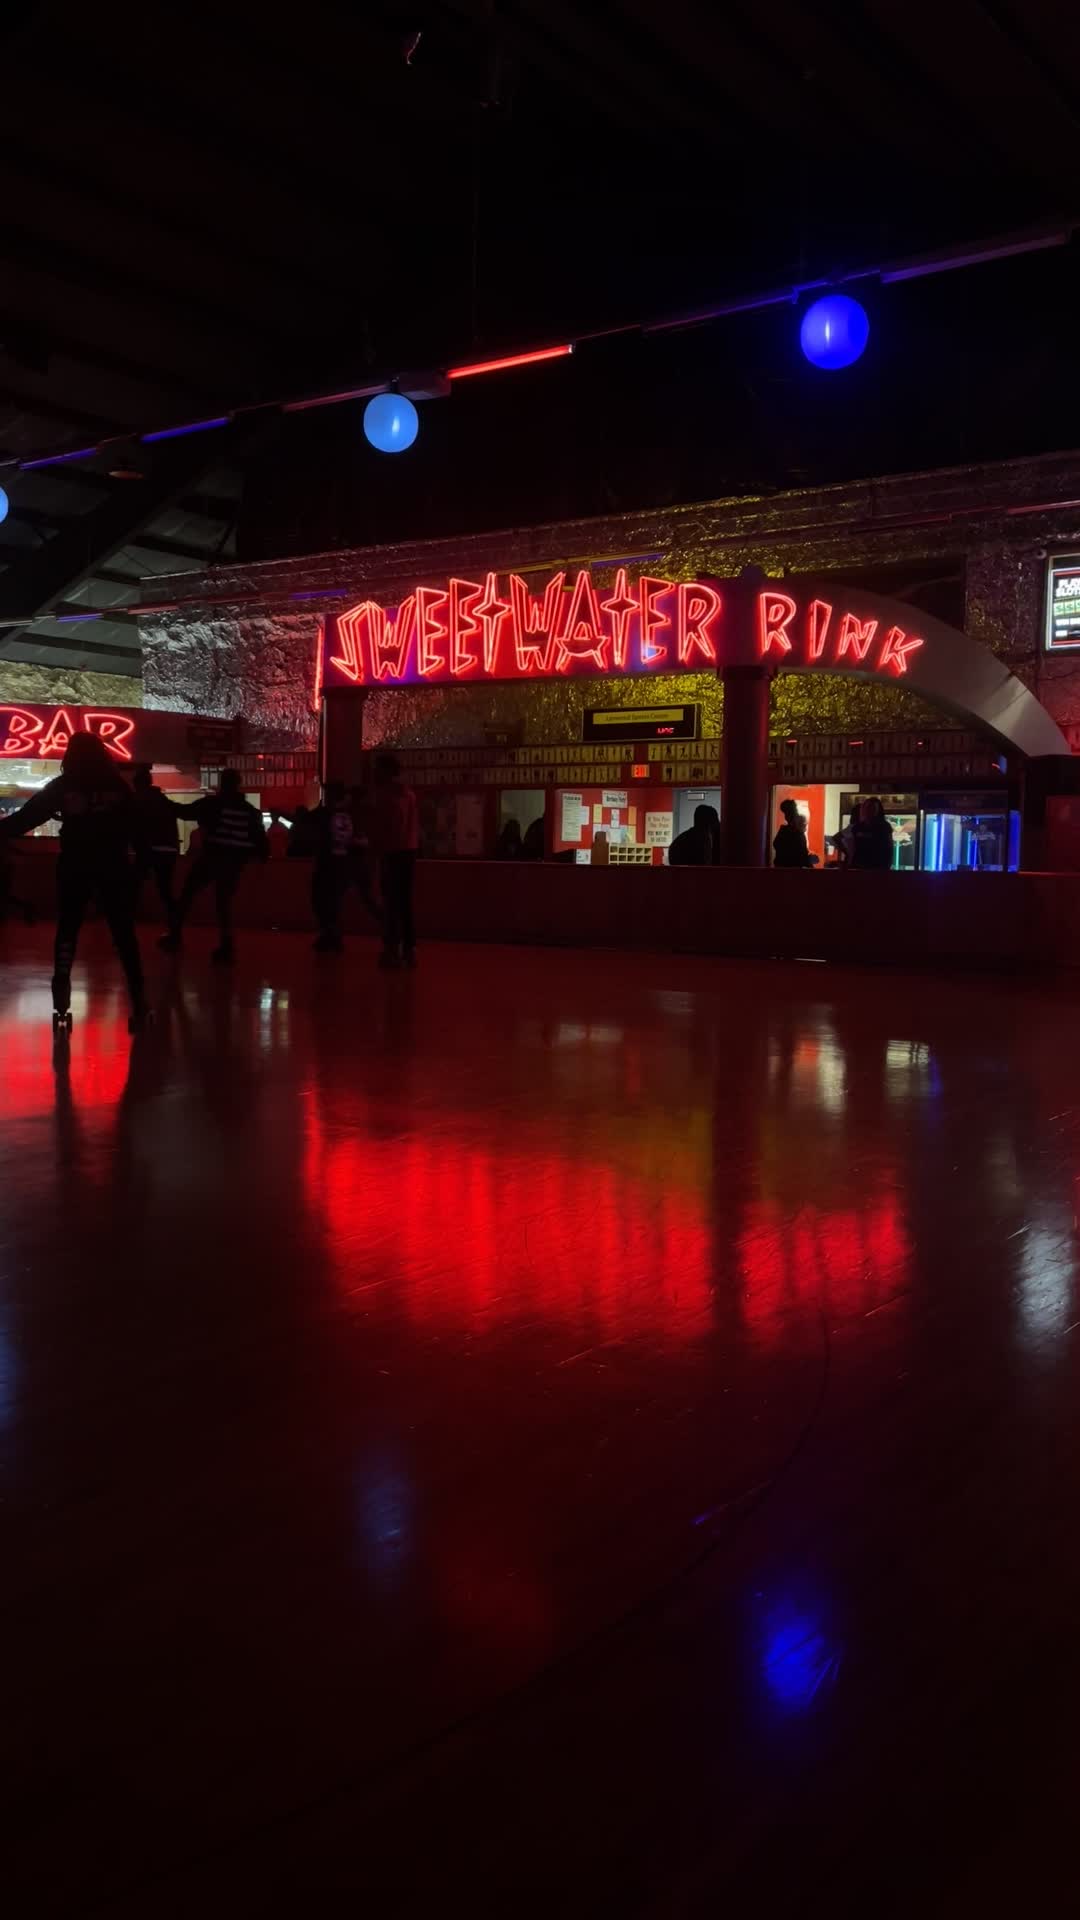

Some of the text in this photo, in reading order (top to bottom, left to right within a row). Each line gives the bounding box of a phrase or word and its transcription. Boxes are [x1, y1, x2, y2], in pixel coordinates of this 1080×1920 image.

[330, 569, 925, 682] SWEETWATER RINK
[0, 706, 135, 759] BAR
